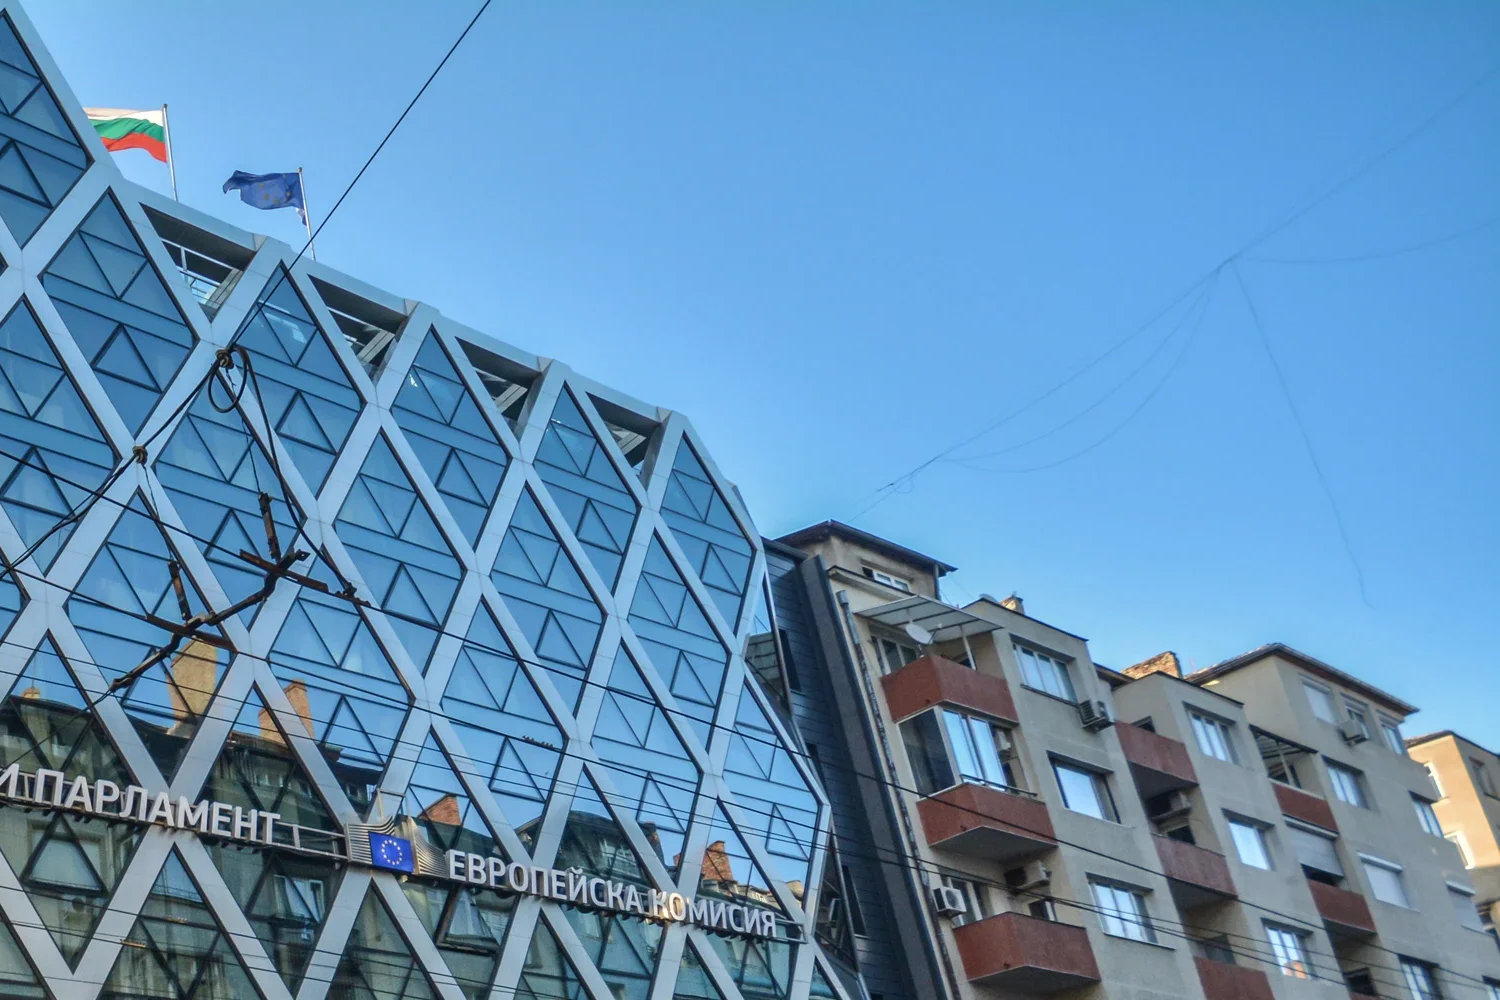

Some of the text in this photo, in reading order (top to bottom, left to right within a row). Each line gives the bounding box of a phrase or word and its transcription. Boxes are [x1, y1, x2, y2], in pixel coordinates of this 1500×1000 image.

[35, 768, 280, 844] ПАРЛАМЕНТ
[448, 849, 777, 938] ЕВРОПЕЙСКА КОМИСИЯ
